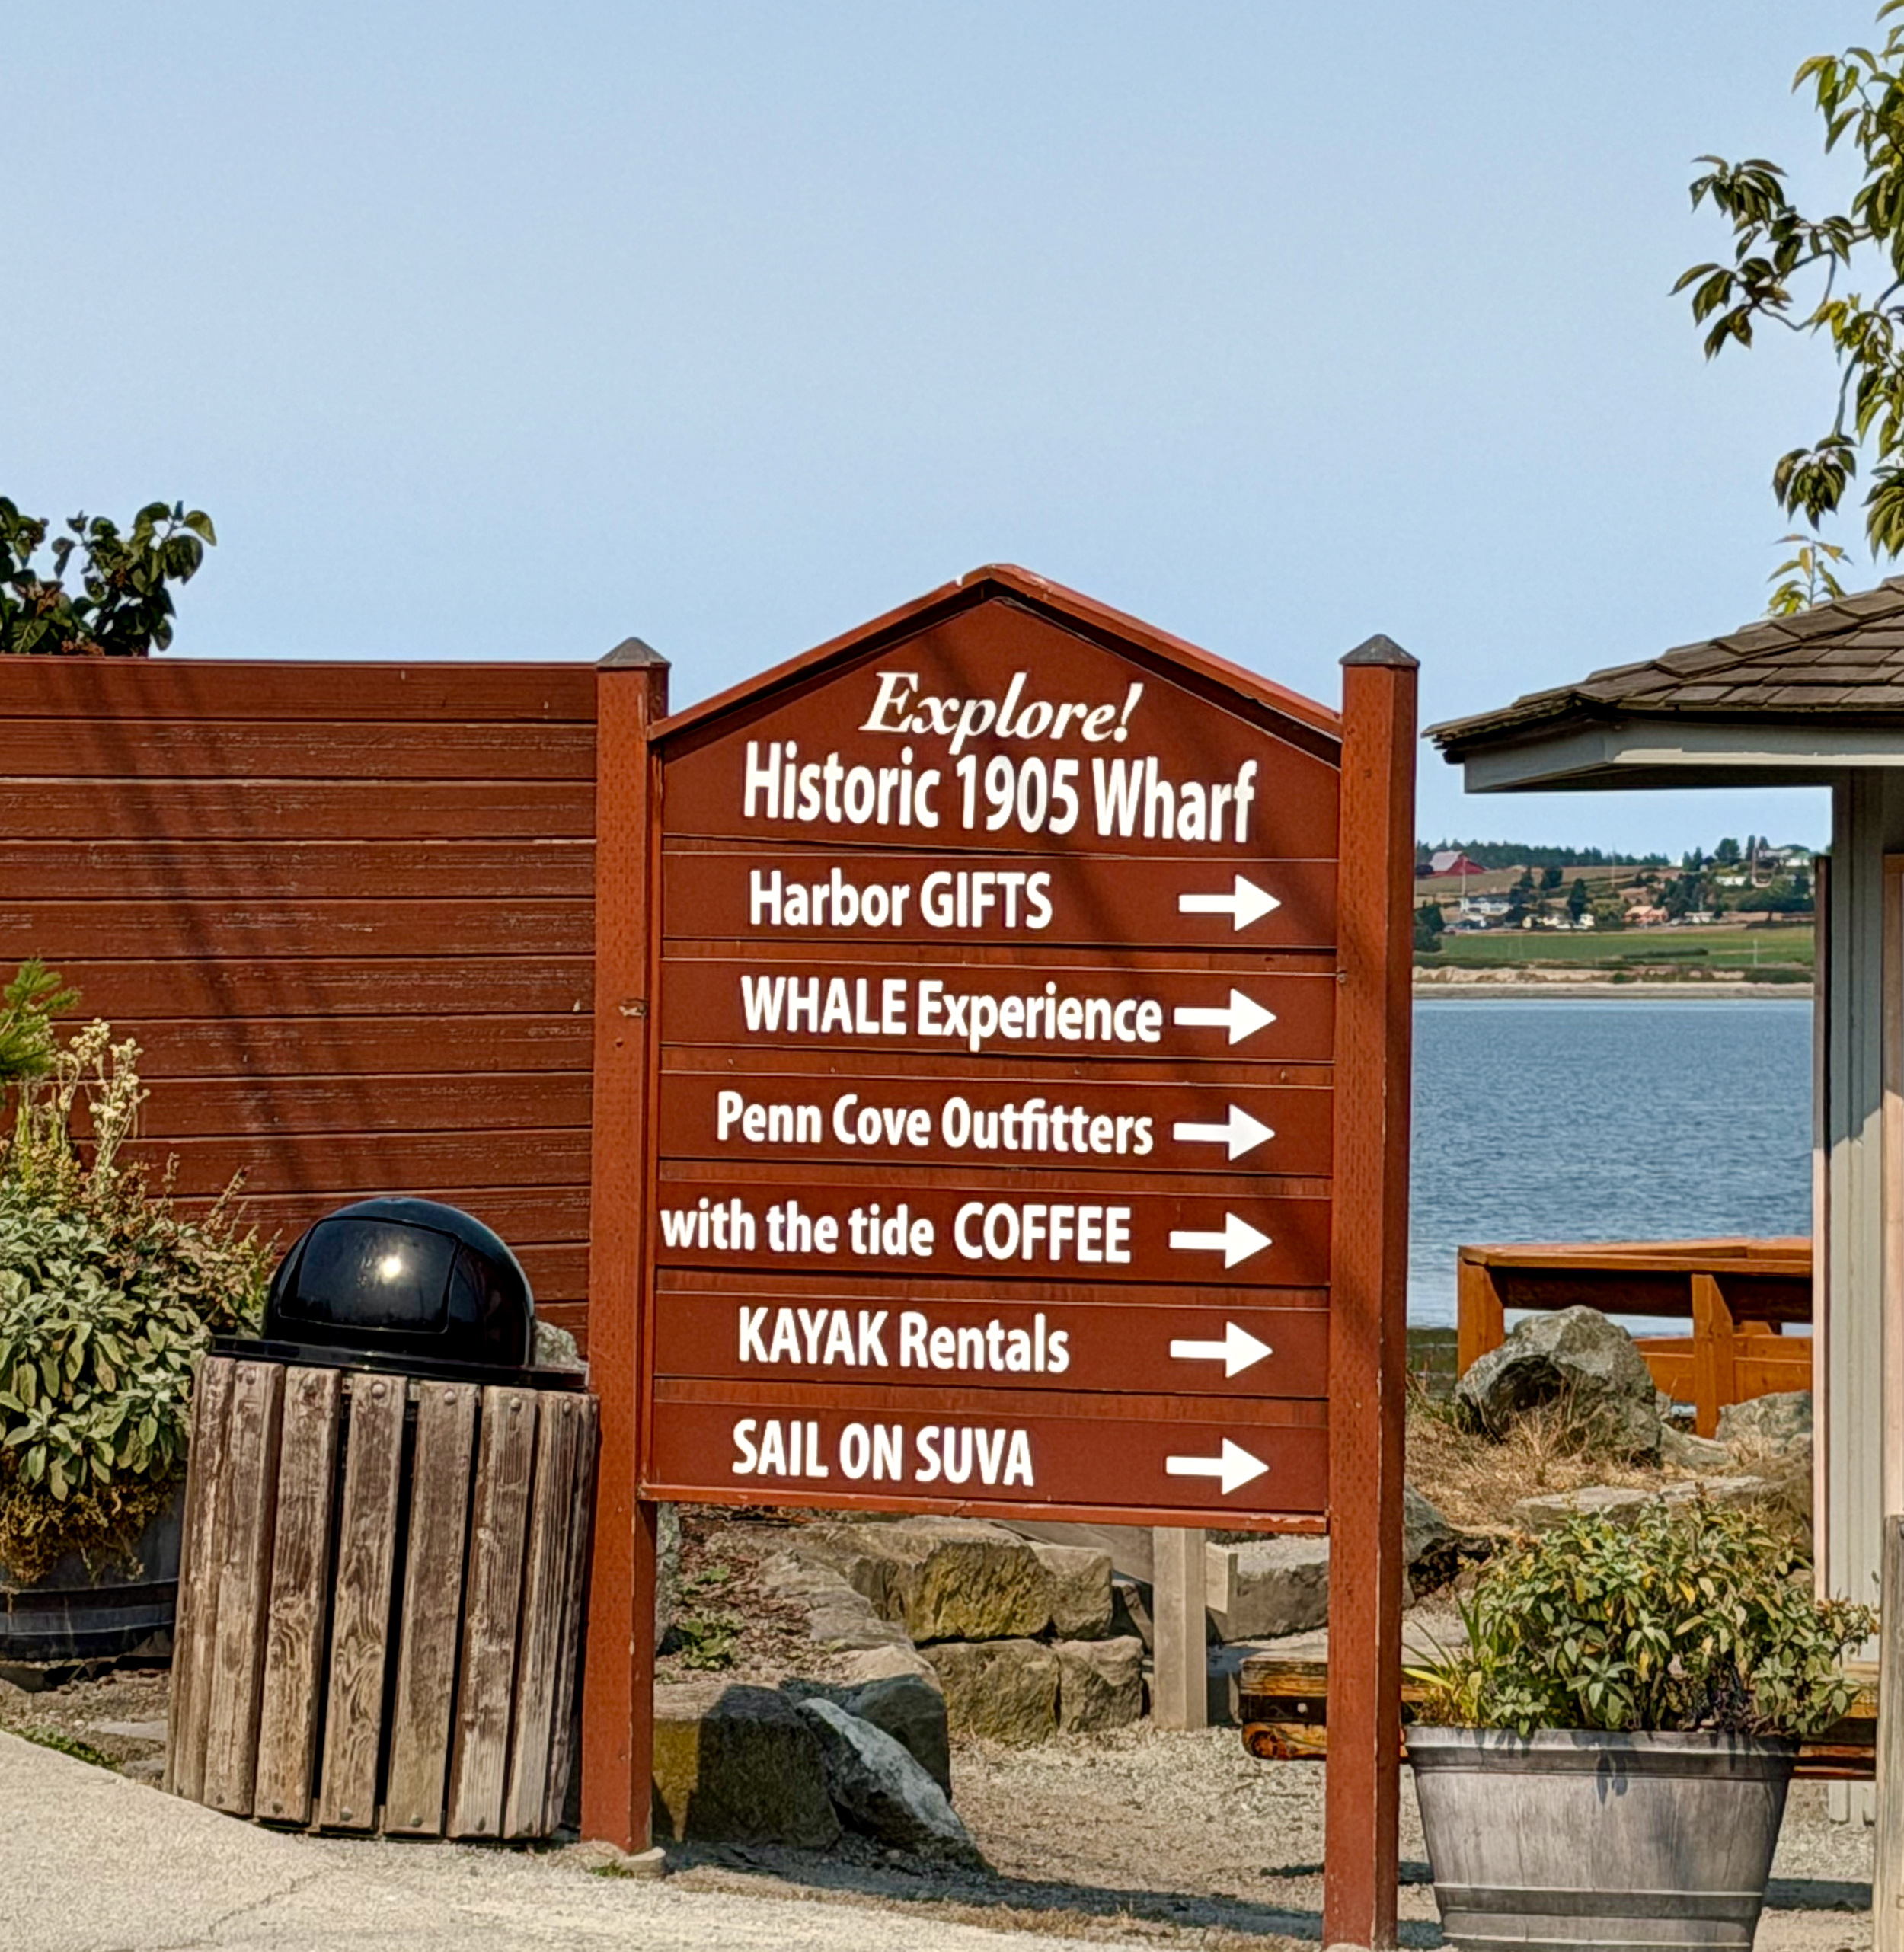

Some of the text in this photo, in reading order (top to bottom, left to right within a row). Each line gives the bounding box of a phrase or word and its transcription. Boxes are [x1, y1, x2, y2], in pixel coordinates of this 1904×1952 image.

[859, 672, 1144, 756] Explore!
[743, 741, 1257, 843] Historic 1905 Wharf
[750, 867, 1053, 929] Harbor GIFTS
[740, 975, 1163, 1053] WHALE Experience
[717, 1091, 1154, 1155] Penn Cove Outfitters
[660, 1197, 1131, 1264] with the tide COFFEE
[739, 1306, 1069, 1373] KAYAK Rentals
[732, 1419, 1034, 1487] SAIL ON SUVA
